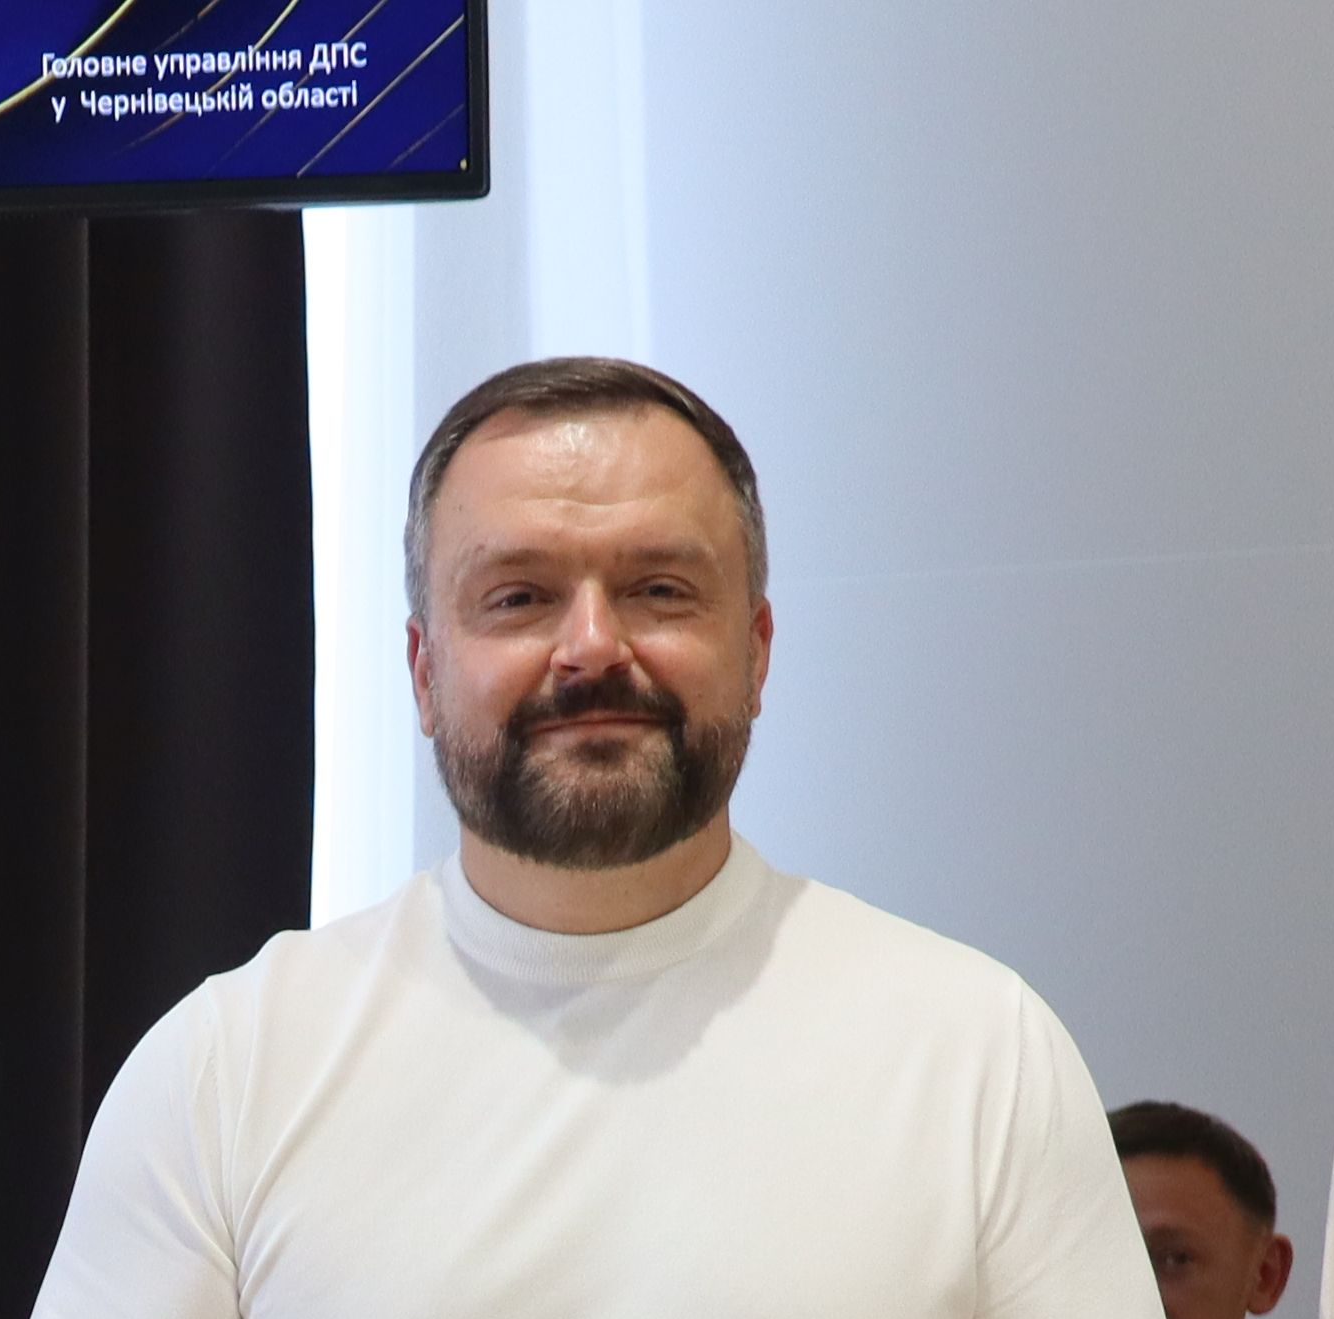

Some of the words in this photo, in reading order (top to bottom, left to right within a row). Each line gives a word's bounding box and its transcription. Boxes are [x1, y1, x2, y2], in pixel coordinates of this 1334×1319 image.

[42, 52, 147, 79] Головне
[154, 44, 302, 81] управління
[308, 41, 368, 75] ДПС
[51, 95, 66, 123] у
[80, 81, 254, 122] Чернівецькій
[261, 80, 358, 110] області
